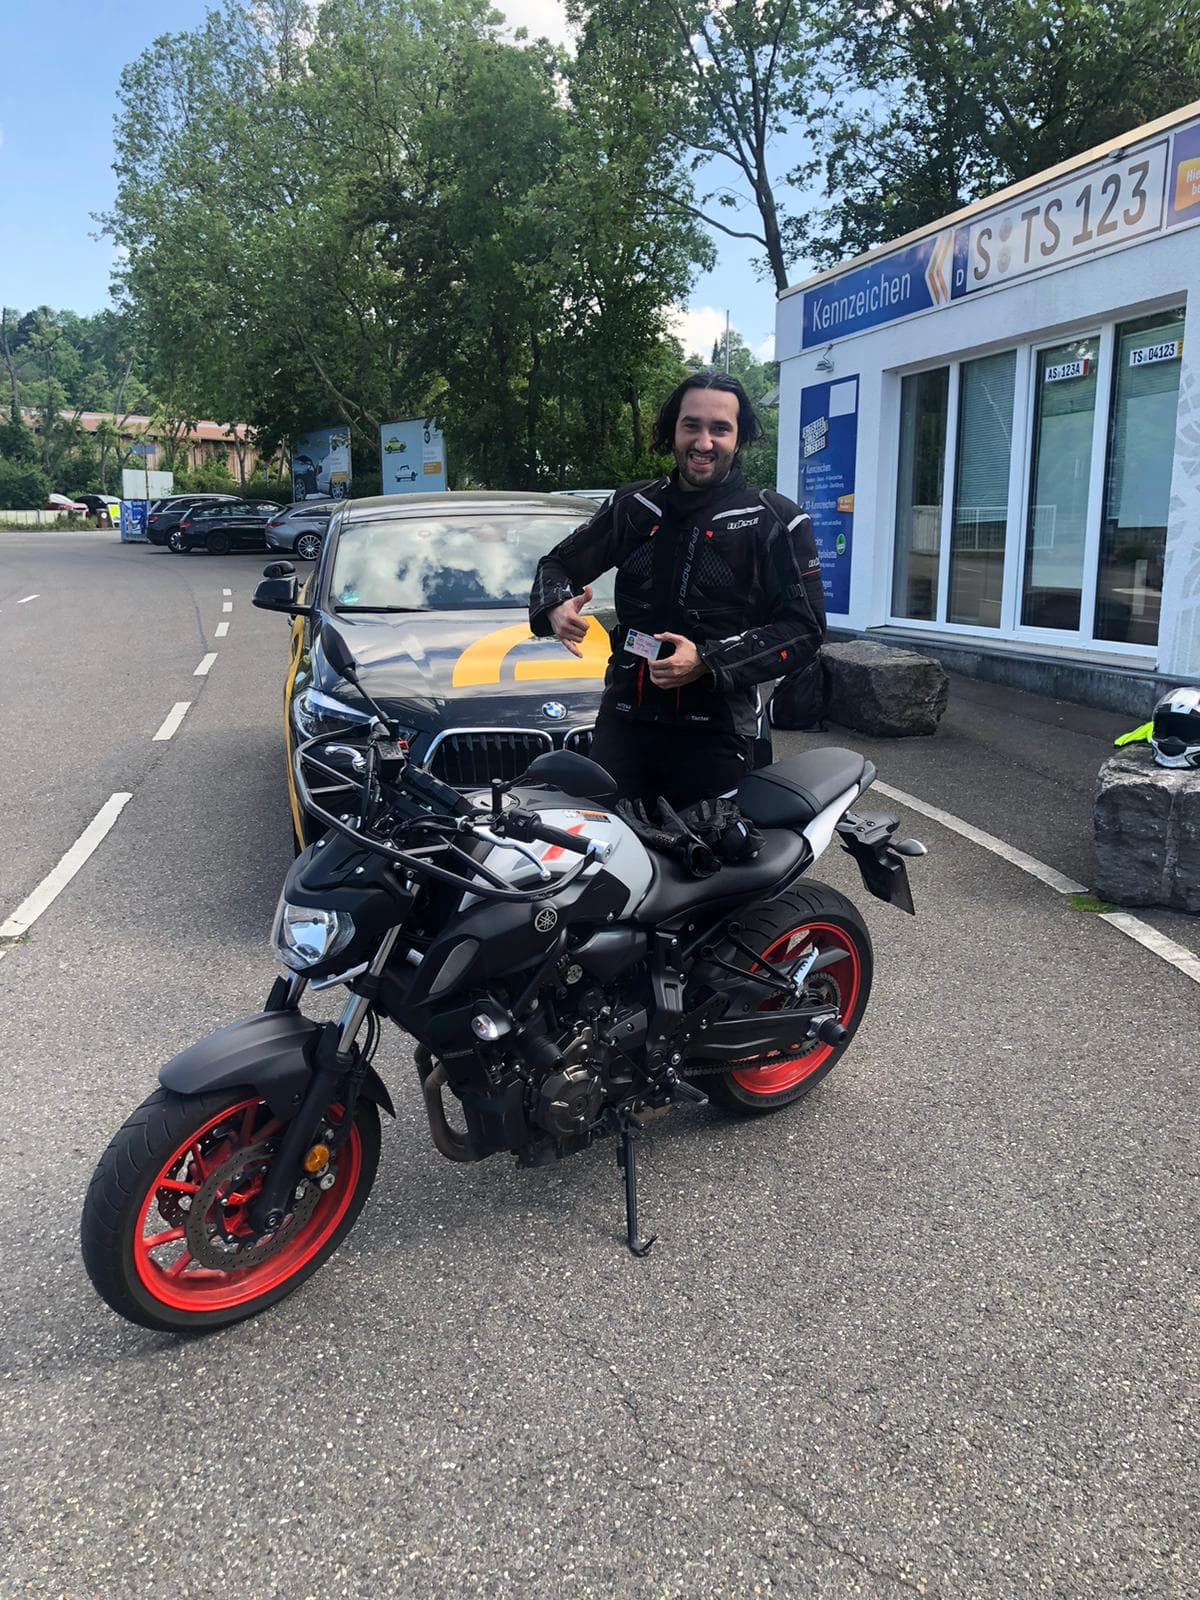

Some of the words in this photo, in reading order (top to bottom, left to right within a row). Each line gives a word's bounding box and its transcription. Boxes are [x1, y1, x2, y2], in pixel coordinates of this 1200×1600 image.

[956, 269, 964, 287] D
[974, 228, 993, 281] S
[1021, 198, 1063, 264] TS
[1072, 160, 1150, 246] 123
[812, 273, 911, 332] Kennzeichen
[1047, 366, 1058, 380] AS
[1061, 363, 1081, 378] 123A
[1133, 350, 1143, 364] TS
